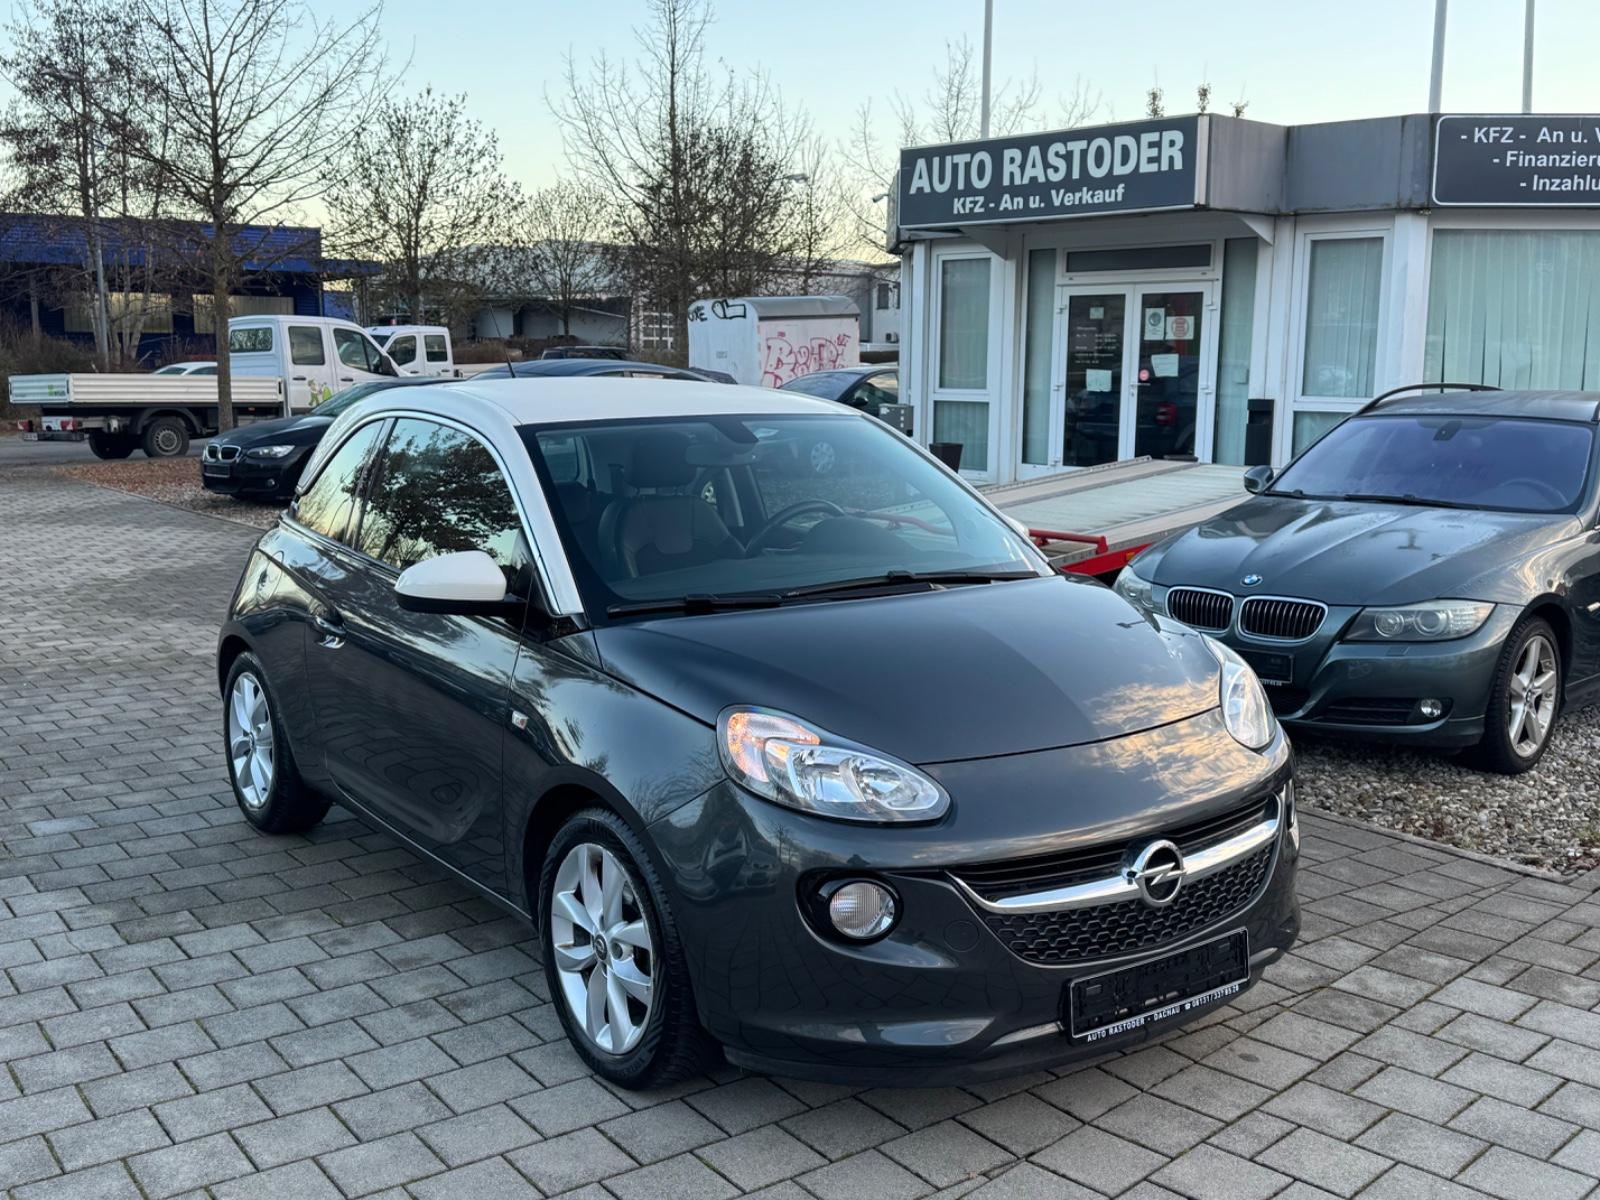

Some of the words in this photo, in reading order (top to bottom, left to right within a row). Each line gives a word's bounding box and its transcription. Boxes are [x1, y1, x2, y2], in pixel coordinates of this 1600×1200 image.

[1474, 127, 1514, 143] KFZ
[1536, 127, 1564, 143] An
[1571, 130, 1588, 143] u.
[909, 151, 993, 195] AUTO
[1002, 130, 1184, 186] RASTODER
[1506, 151, 1600, 167] Finanzier
[953, 196, 985, 214] KFZ
[999, 194, 1023, 211] An
[1029, 196, 1045, 209] u.
[1050, 184, 1125, 207] Verkauf
[1087, 1030, 1106, 1043] AUTO
[1108, 1018, 1145, 1035] RASTODER
[1153, 1006, 1181, 1021] DACHAU
